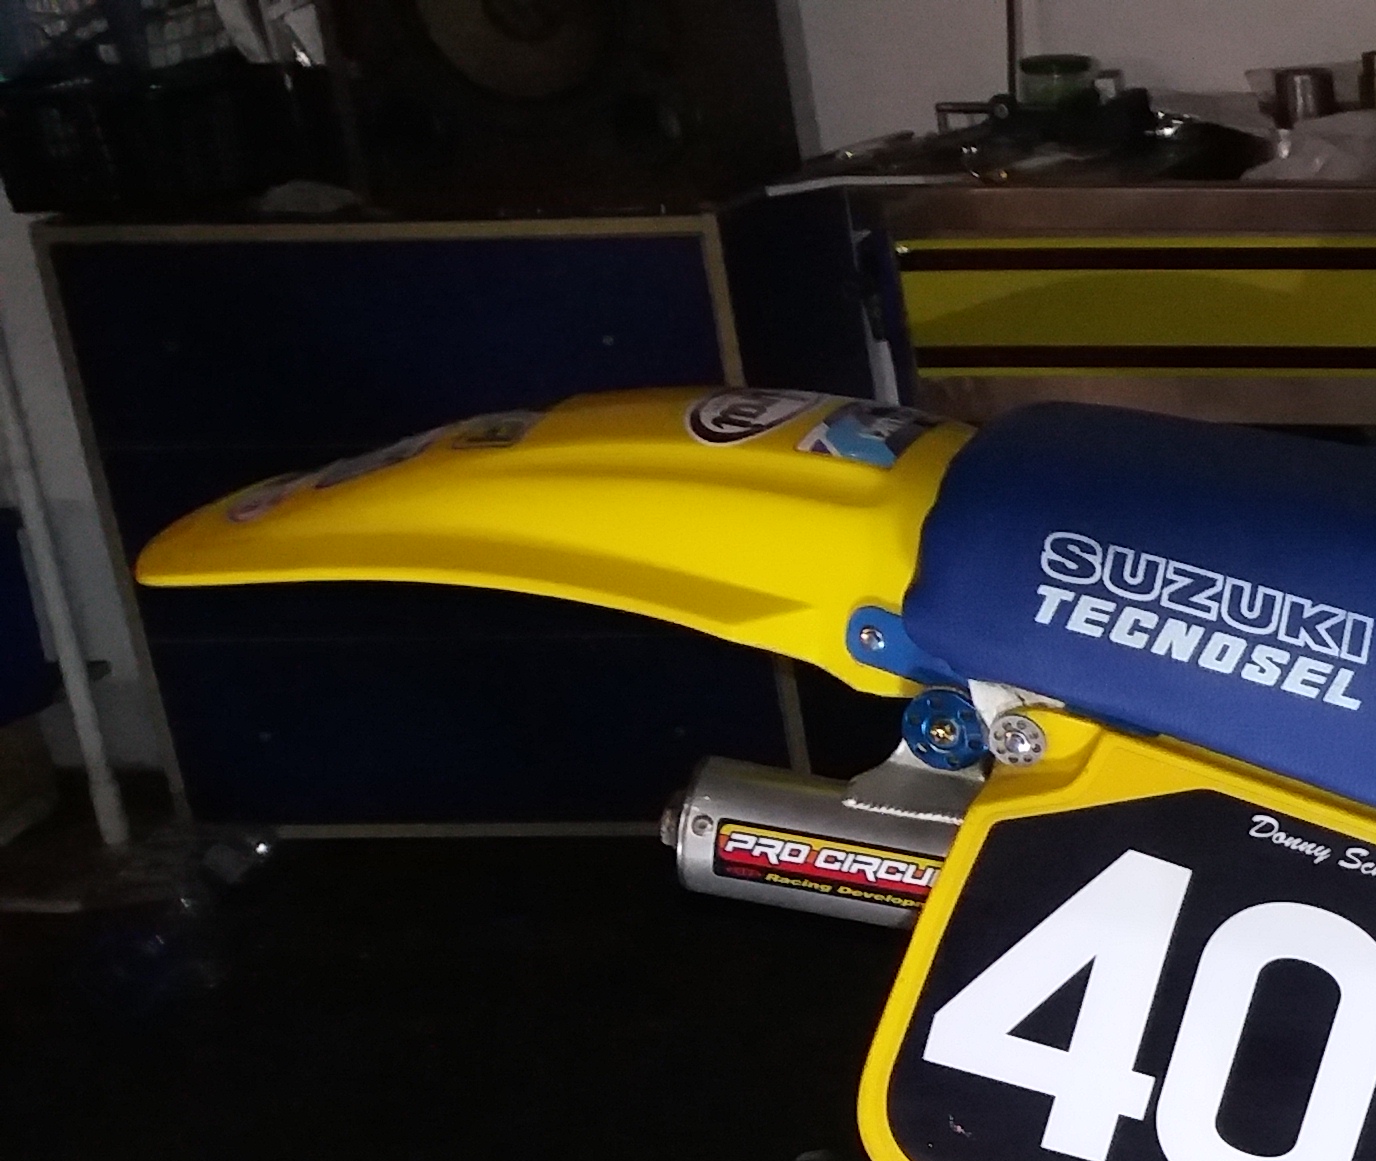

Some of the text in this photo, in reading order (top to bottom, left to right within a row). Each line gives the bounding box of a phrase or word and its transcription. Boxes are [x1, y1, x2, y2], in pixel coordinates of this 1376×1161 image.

[1040, 530, 1375, 665] SUZUKI
[1034, 584, 1363, 711] TECNOSEL
[723, 832, 812, 865] PRO
[1248, 814, 1332, 865] Donny
[764, 873, 833, 893] Racing
